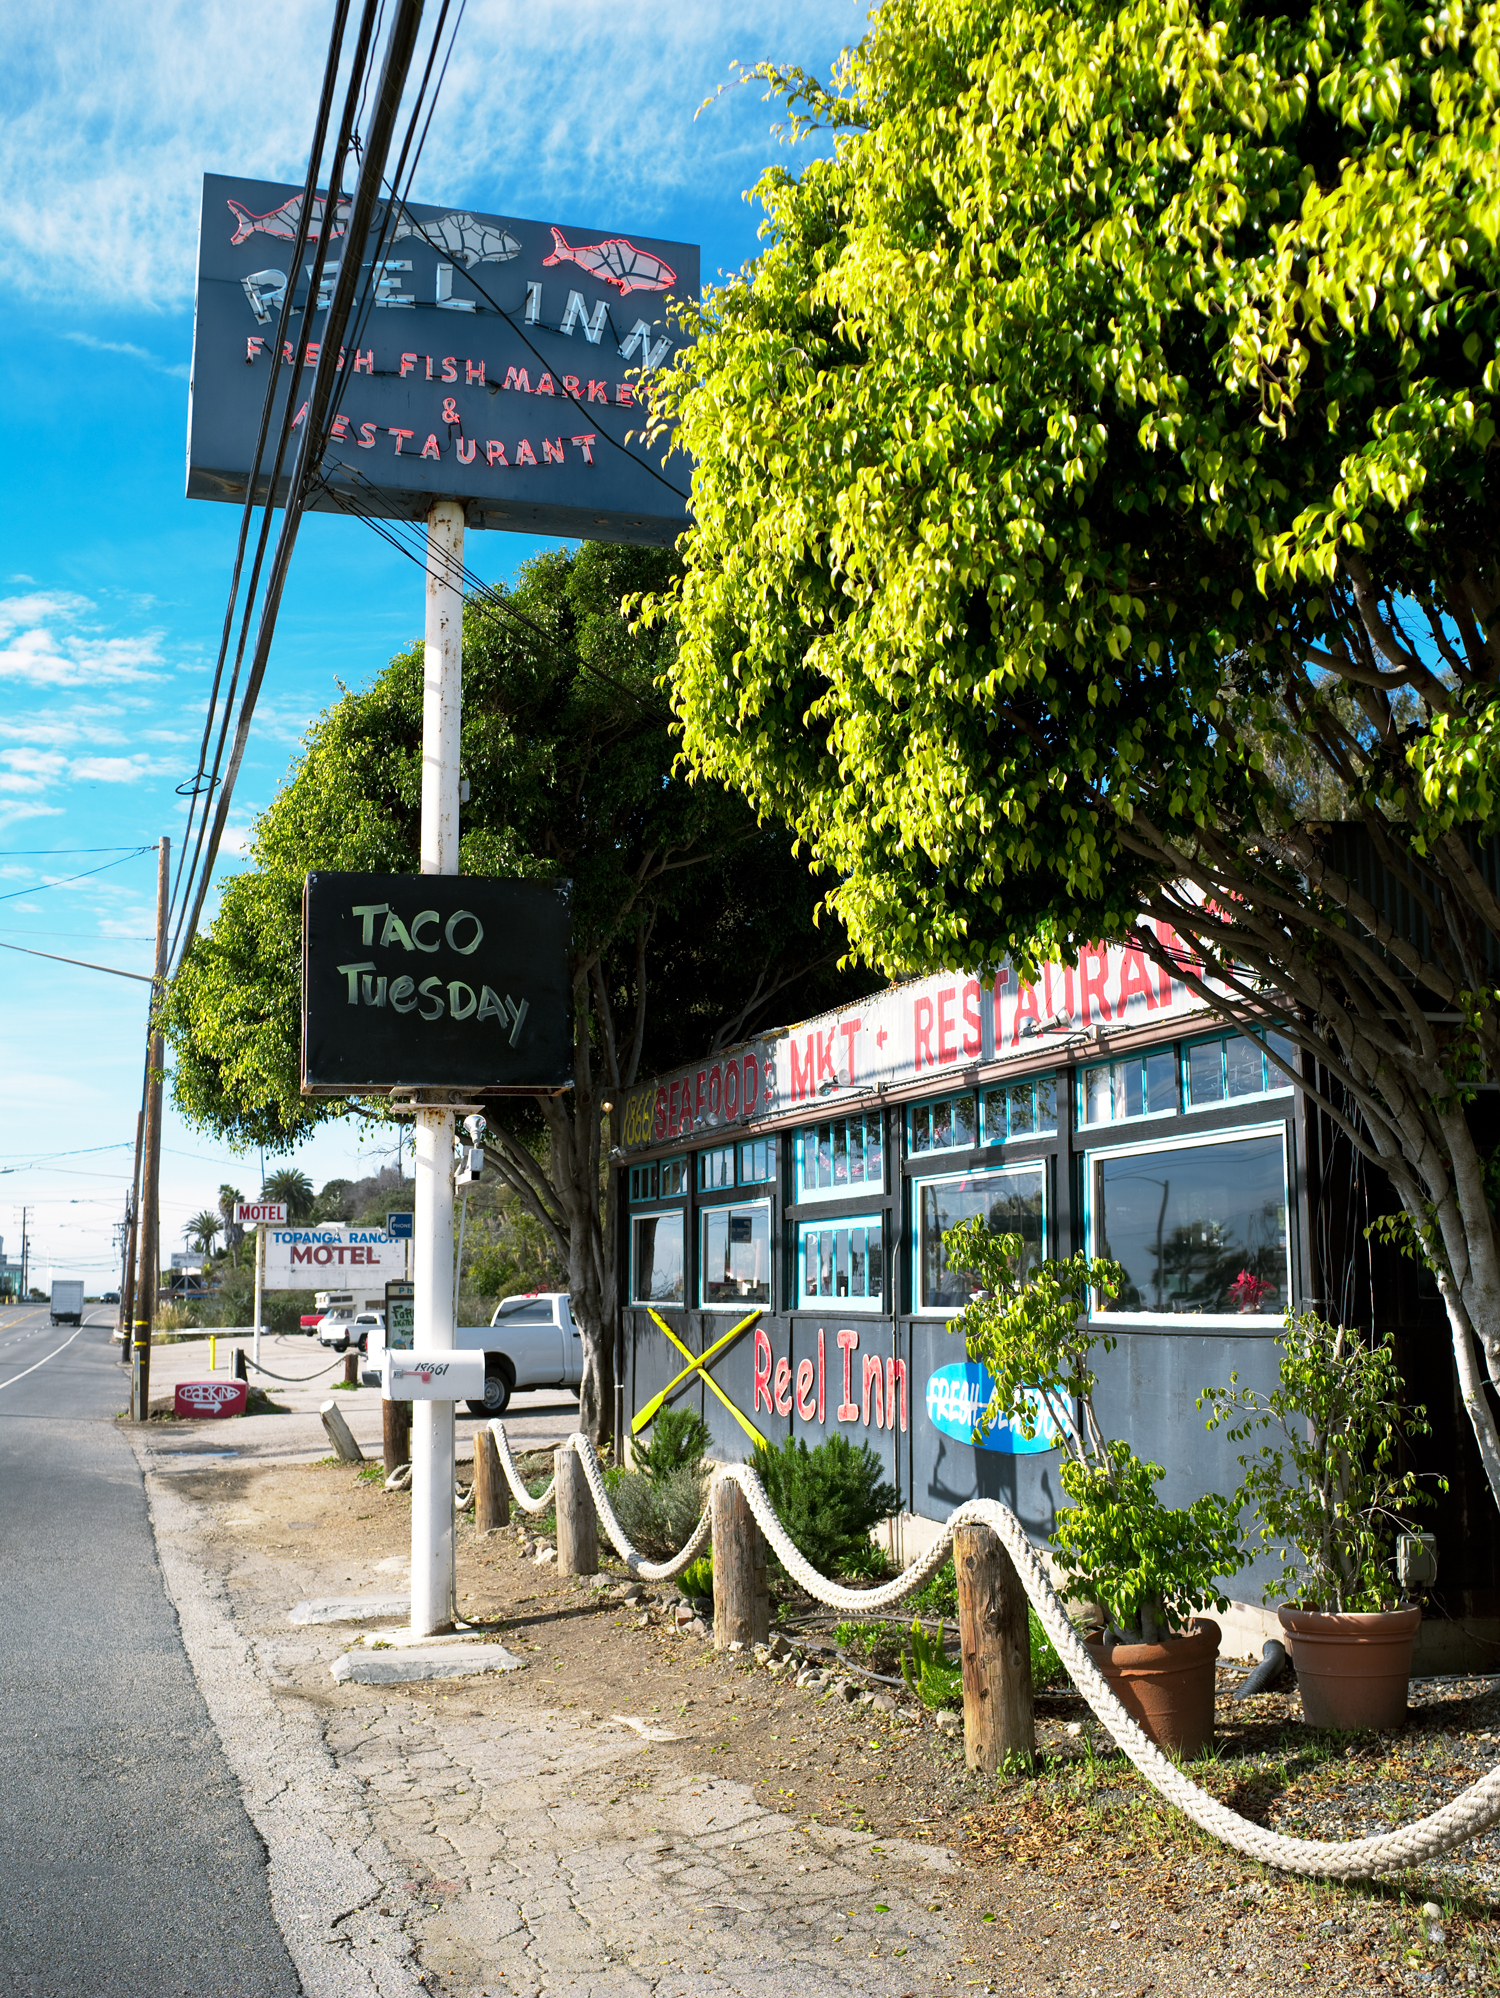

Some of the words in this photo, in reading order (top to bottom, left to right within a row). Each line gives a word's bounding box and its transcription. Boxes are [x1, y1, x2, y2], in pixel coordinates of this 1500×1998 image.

[525, 281, 673, 374] INN
[399, 352, 486, 387] FISH
[291, 401, 597, 467] ESTAURANT
[441, 397, 461, 424] &
[352, 903, 484, 955] TACO
[655, 1053, 758, 1141] SEAFOOD
[790, 1018, 861, 1102] MKT
[239, 1205, 284, 1220] MOTEL
[273, 1232, 342, 1243] TOPANGA
[290, 1246, 380, 1265] MOTEL
[754, 1328, 825, 1425] Reel
[837, 1329, 907, 1433] Inn
[927, 1377, 980, 1427] FRESH
